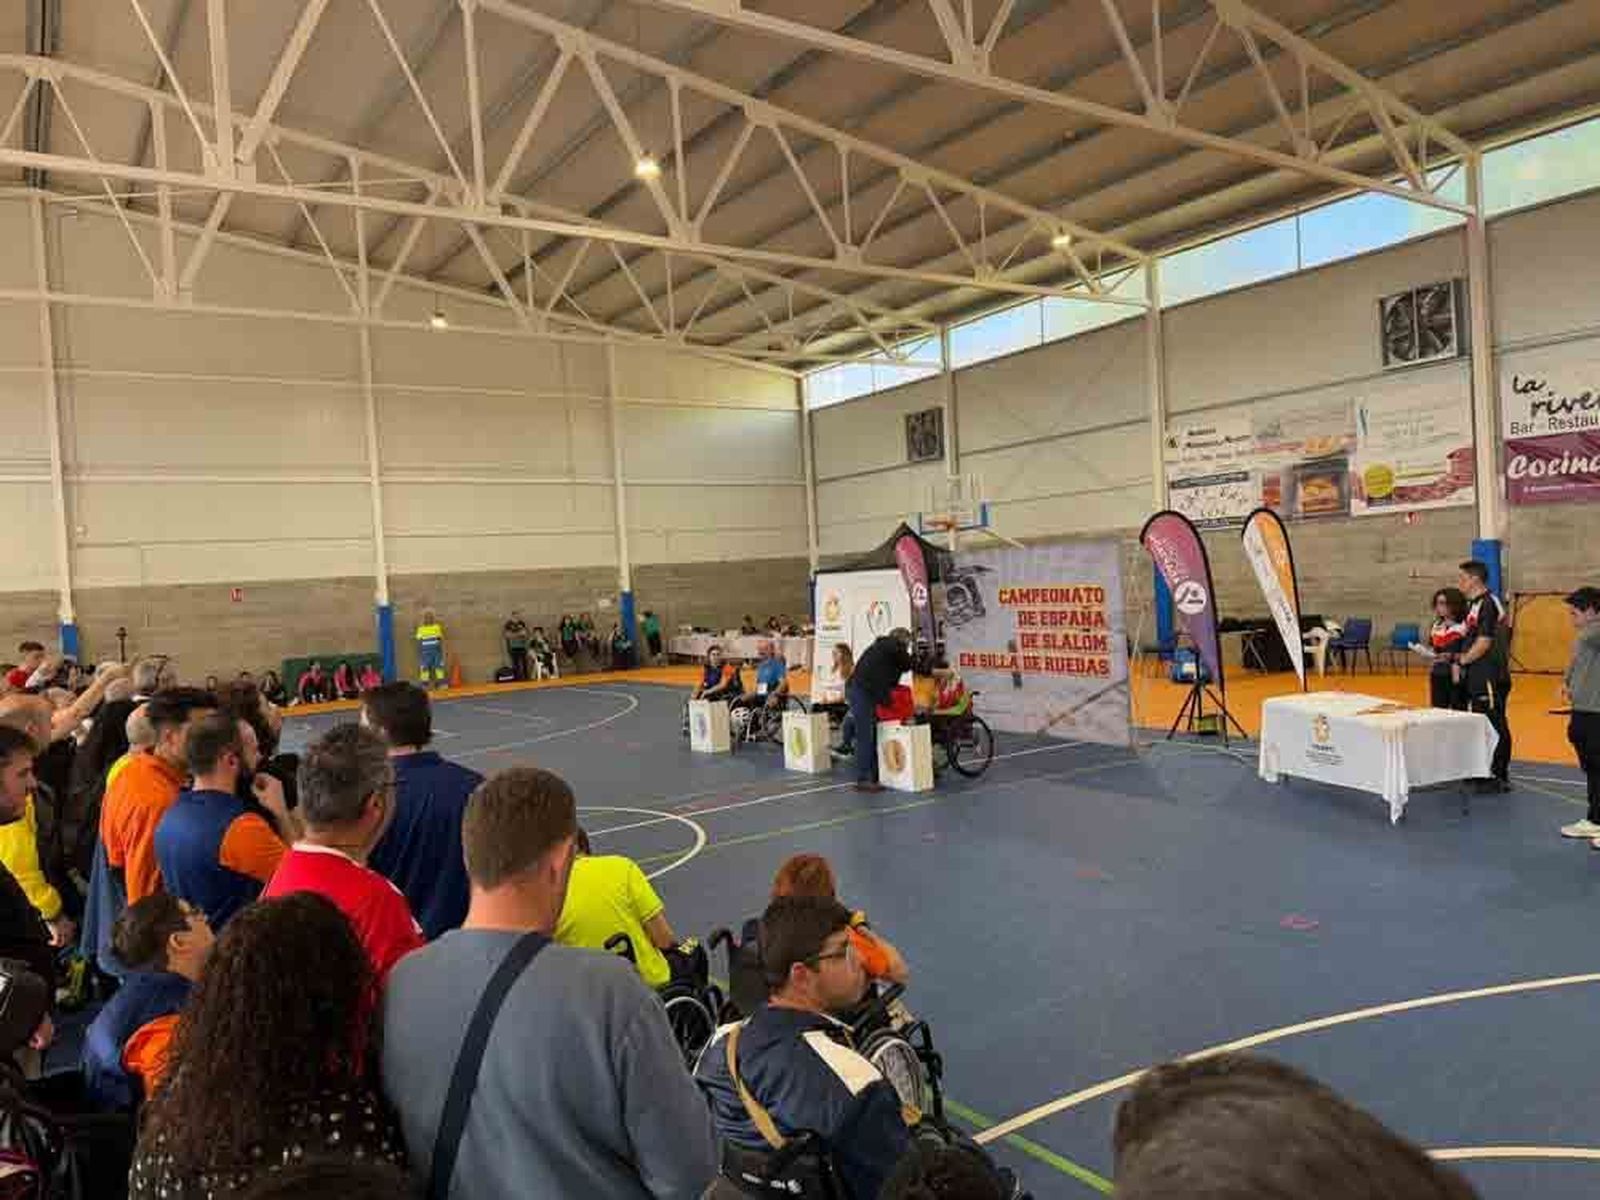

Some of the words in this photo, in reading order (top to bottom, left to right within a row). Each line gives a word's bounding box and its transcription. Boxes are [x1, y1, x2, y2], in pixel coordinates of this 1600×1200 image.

[1531, 391, 1600, 418] rive
[1510, 421, 1534, 435] Bar
[998, 586, 1105, 605] CAMPEONATO
[1018, 611, 1037, 626] DE
[1040, 606, 1105, 627] ESPAÑA
[1021, 633, 1038, 649] DE
[1042, 633, 1107, 651] SLALOM
[959, 652, 976, 667] EN
[979, 654, 1019, 669] SILLA
[1023, 655, 1042, 671] DE
[1044, 655, 1110, 675] RUEDAS
